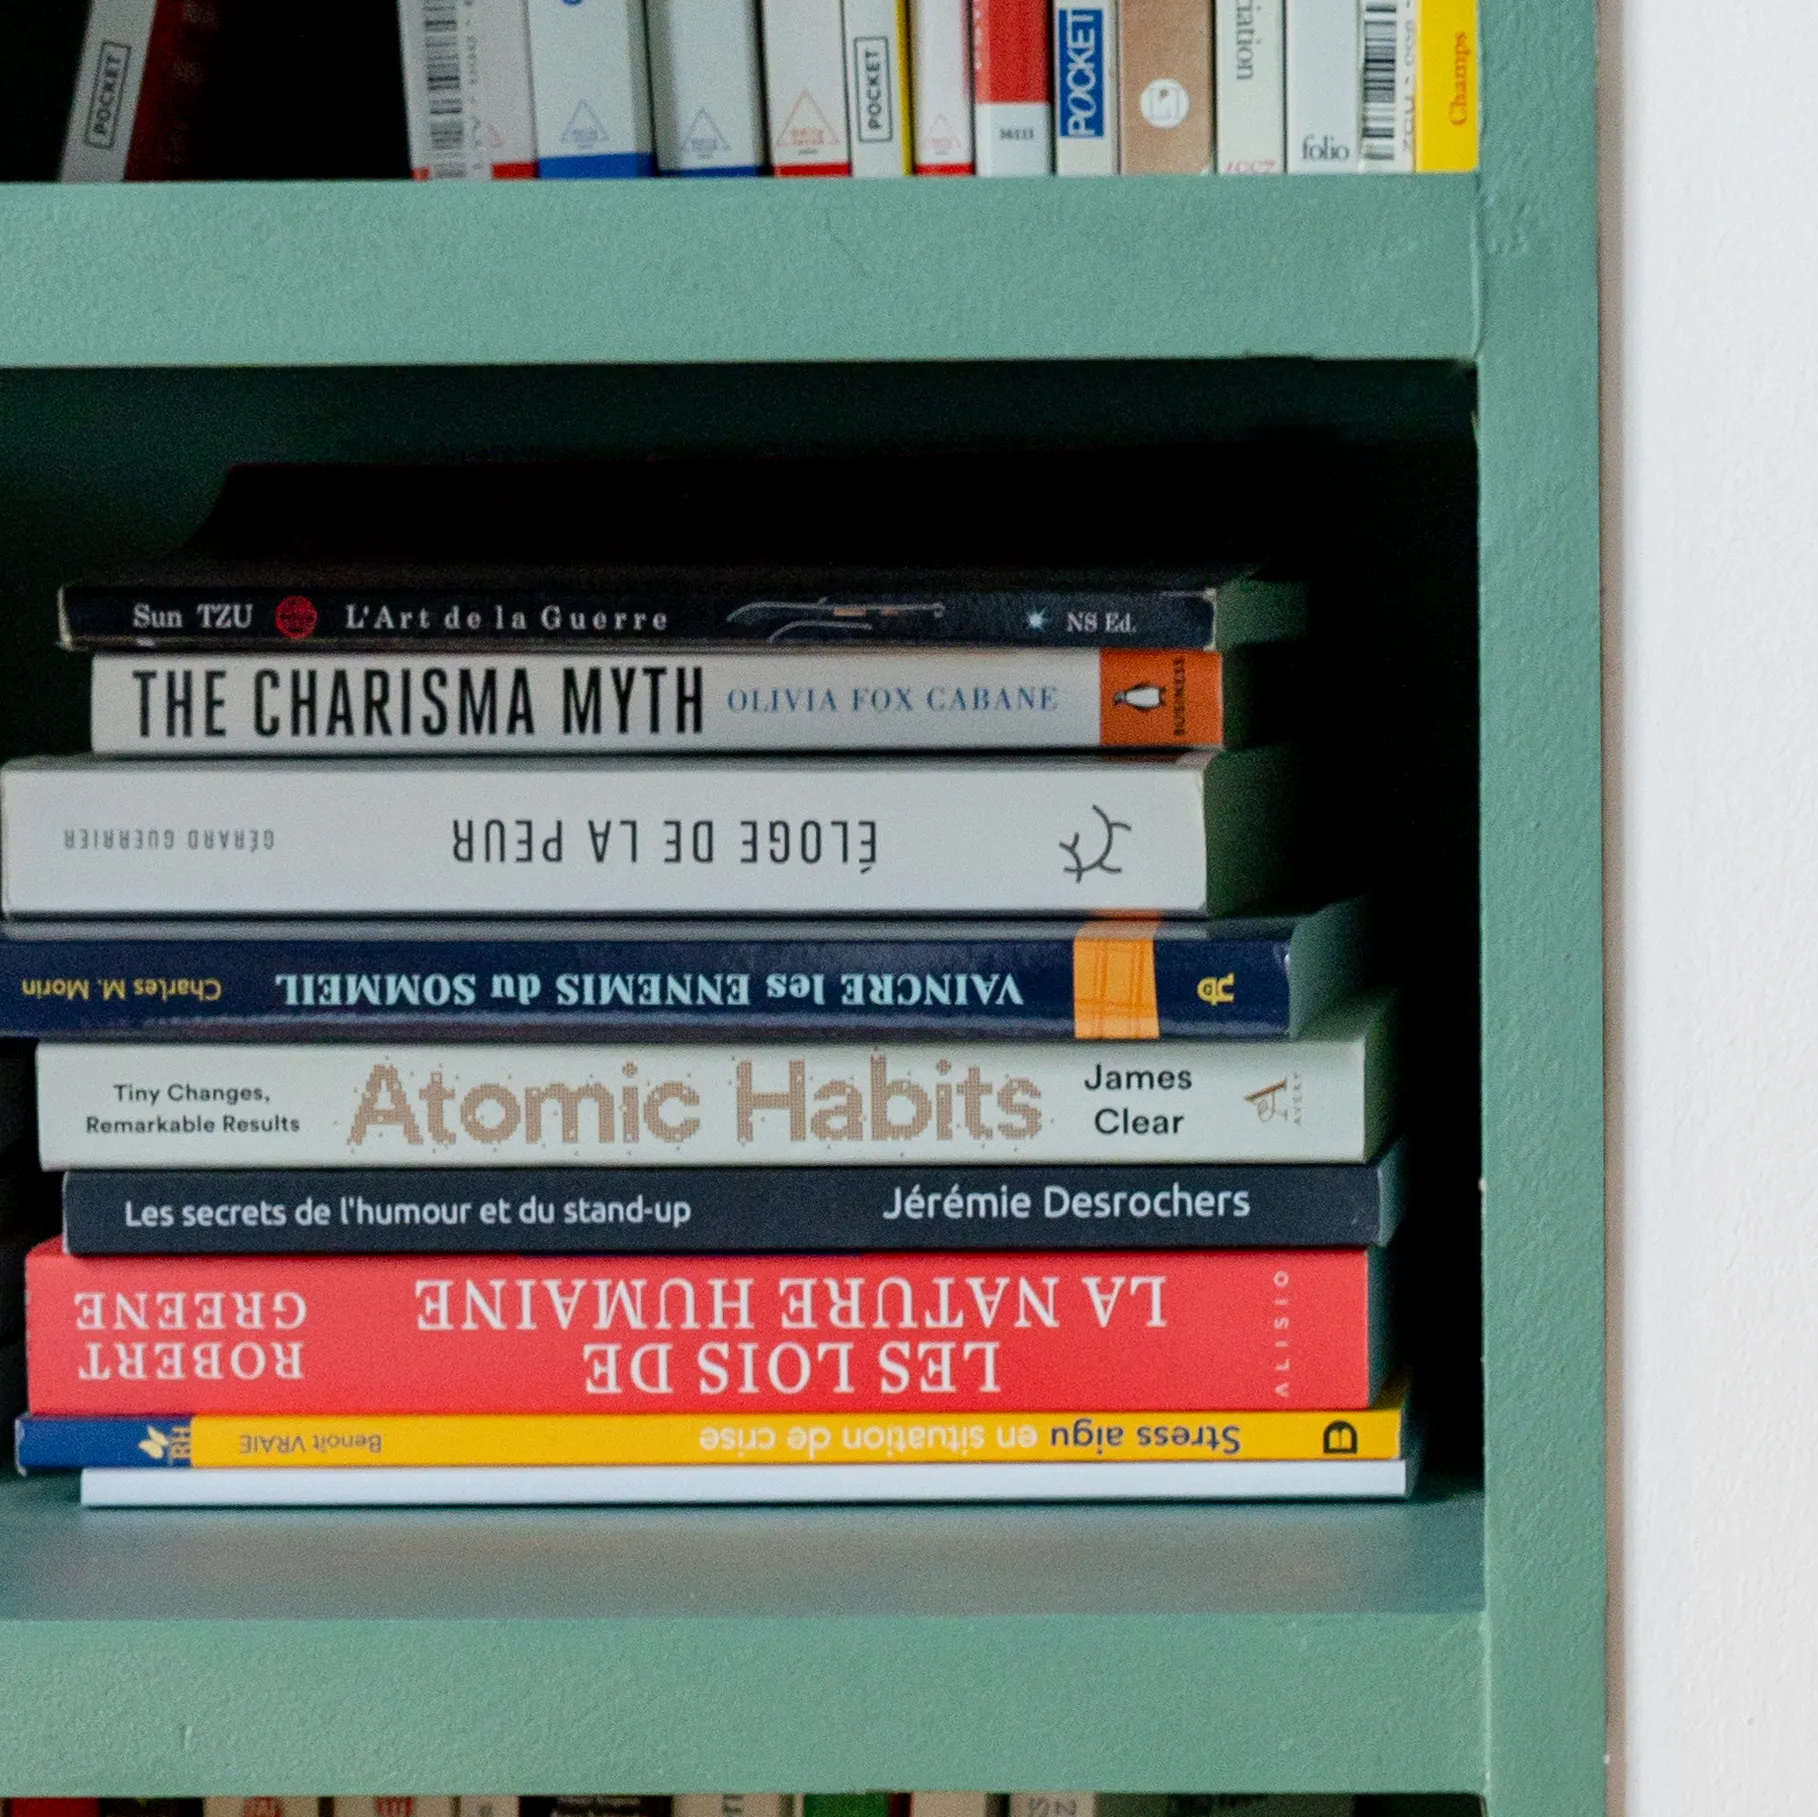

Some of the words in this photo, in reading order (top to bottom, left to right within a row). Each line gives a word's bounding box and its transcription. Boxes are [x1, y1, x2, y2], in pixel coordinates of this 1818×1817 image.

[1067, 11, 1095, 135] POCKET
[132, 603, 184, 629] Sun
[197, 603, 253, 629] TZU
[345, 604, 430, 630] L'Art
[444, 606, 485, 630] de
[496, 606, 528, 630] la
[540, 606, 668, 631] Guerre
[133, 671, 227, 737] THE
[253, 668, 534, 737] CHARISMA
[562, 667, 703, 736] MYTH
[728, 687, 837, 713] OLIVIA
[852, 687, 913, 710] FOX
[926, 685, 1059, 710] CABANE
[453, 820, 562, 862] PEUR
[588, 820, 638, 862] LA
[664, 821, 714, 863] DE
[740, 820, 877, 873] ÉLOGE
[21, 979, 91, 1000] Morin
[98, 979, 125, 1000] M.
[135, 979, 221, 1002] Charles
[274, 973, 475, 1006] SOMMEIL
[491, 975, 541, 1006] du
[554, 973, 751, 1005] ENNEMIS
[767, 973, 825, 1000] les
[842, 974, 1023, 1004] VAINCRE
[1085, 1064, 1193, 1092] James
[114, 1084, 159, 1107] Tiny
[168, 1084, 271, 1106] Changes,
[347, 1058, 701, 1147] Atomic
[735, 1053, 1043, 1142] Habits
[86, 1115, 217, 1135] Remarkable
[223, 1115, 300, 1134] Results
[1094, 1109, 1185, 1136] Clear
[125, 1200, 174, 1228] Les
[183, 1201, 287, 1228] secrets
[295, 1198, 330, 1225] de
[340, 1197, 471, 1225] l'humour
[479, 1200, 511, 1225] et
[519, 1196, 556, 1224] du
[564, 1194, 692, 1228] stand-up
[883, 1187, 1030, 1219] Jérémie
[1044, 1185, 1251, 1218] Desrochers
[74, 1291, 307, 1331] GREENE
[415, 1278, 754, 1331] HUMAINE
[779, 1277, 1060, 1329] NATURE
[1083, 1277, 1168, 1329] LA
[1274, 1270, 1290, 1397] ALISIO
[78, 1342, 304, 1379] ROBERT
[585, 1343, 673, 1394] DE
[696, 1342, 855, 1394] LOIS
[878, 1342, 1001, 1394] LES
[699, 1427, 775, 1450] crise
[787, 1427, 830, 1453] de
[843, 1427, 983, 1452] situation
[1000, 1427, 1037, 1449] en
[1050, 1421, 1123, 1452] aigu
[1135, 1421, 1241, 1452] Stress
